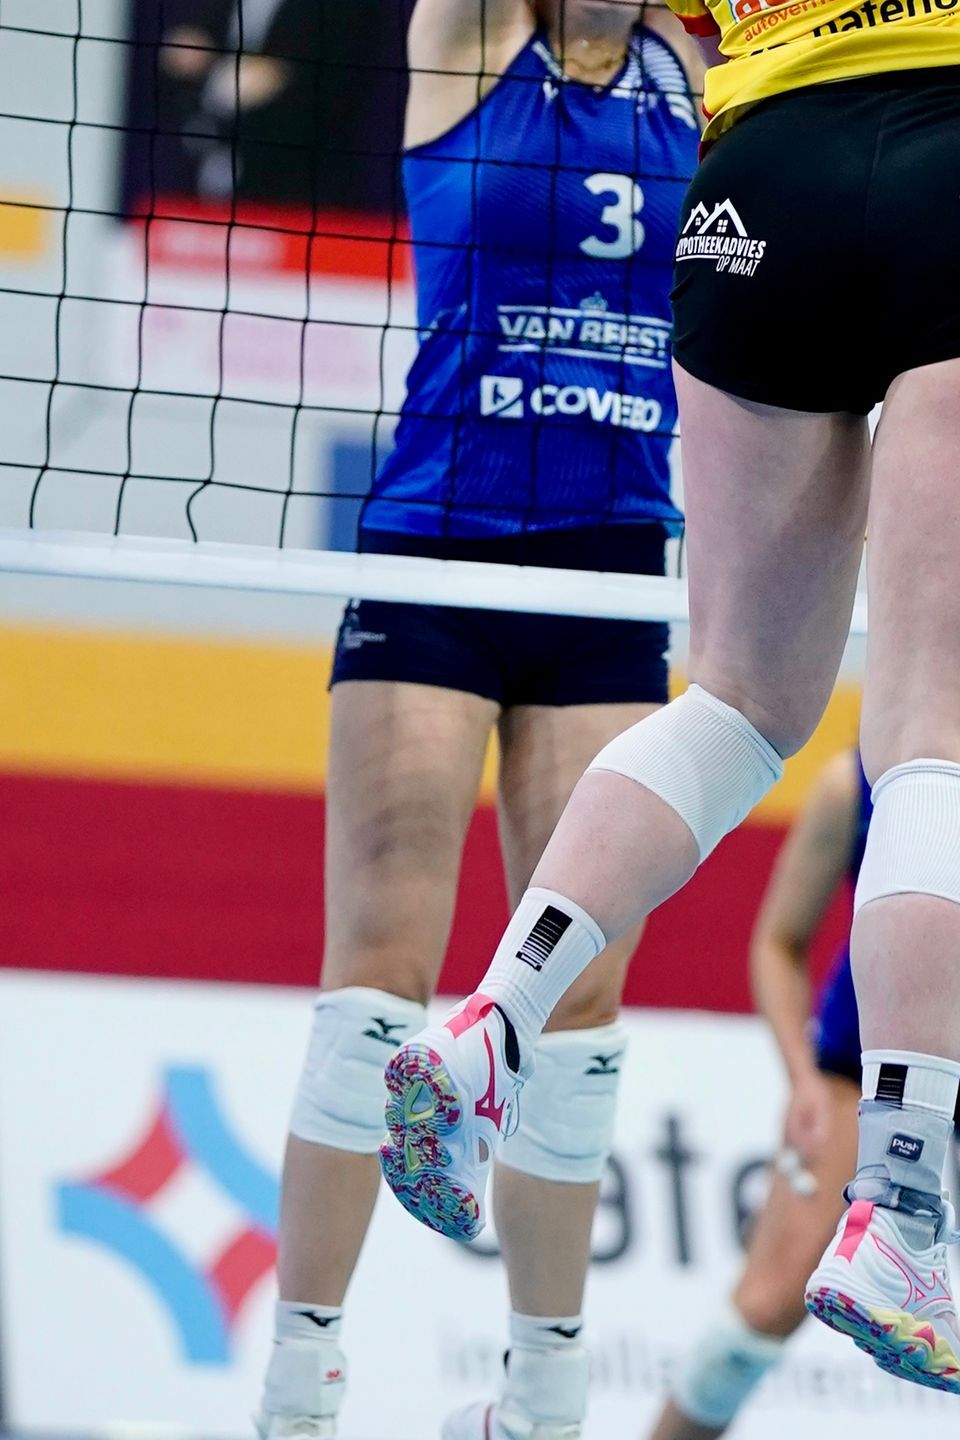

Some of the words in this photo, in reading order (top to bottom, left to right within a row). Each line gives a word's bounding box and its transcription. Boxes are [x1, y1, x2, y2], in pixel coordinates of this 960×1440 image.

[579, 172, 645, 259] 3
[716, 255, 731, 272] OP
[728, 257, 761, 277] MAAT
[498, 315, 575, 342] VAN
[892, 1138, 919, 1152] push
